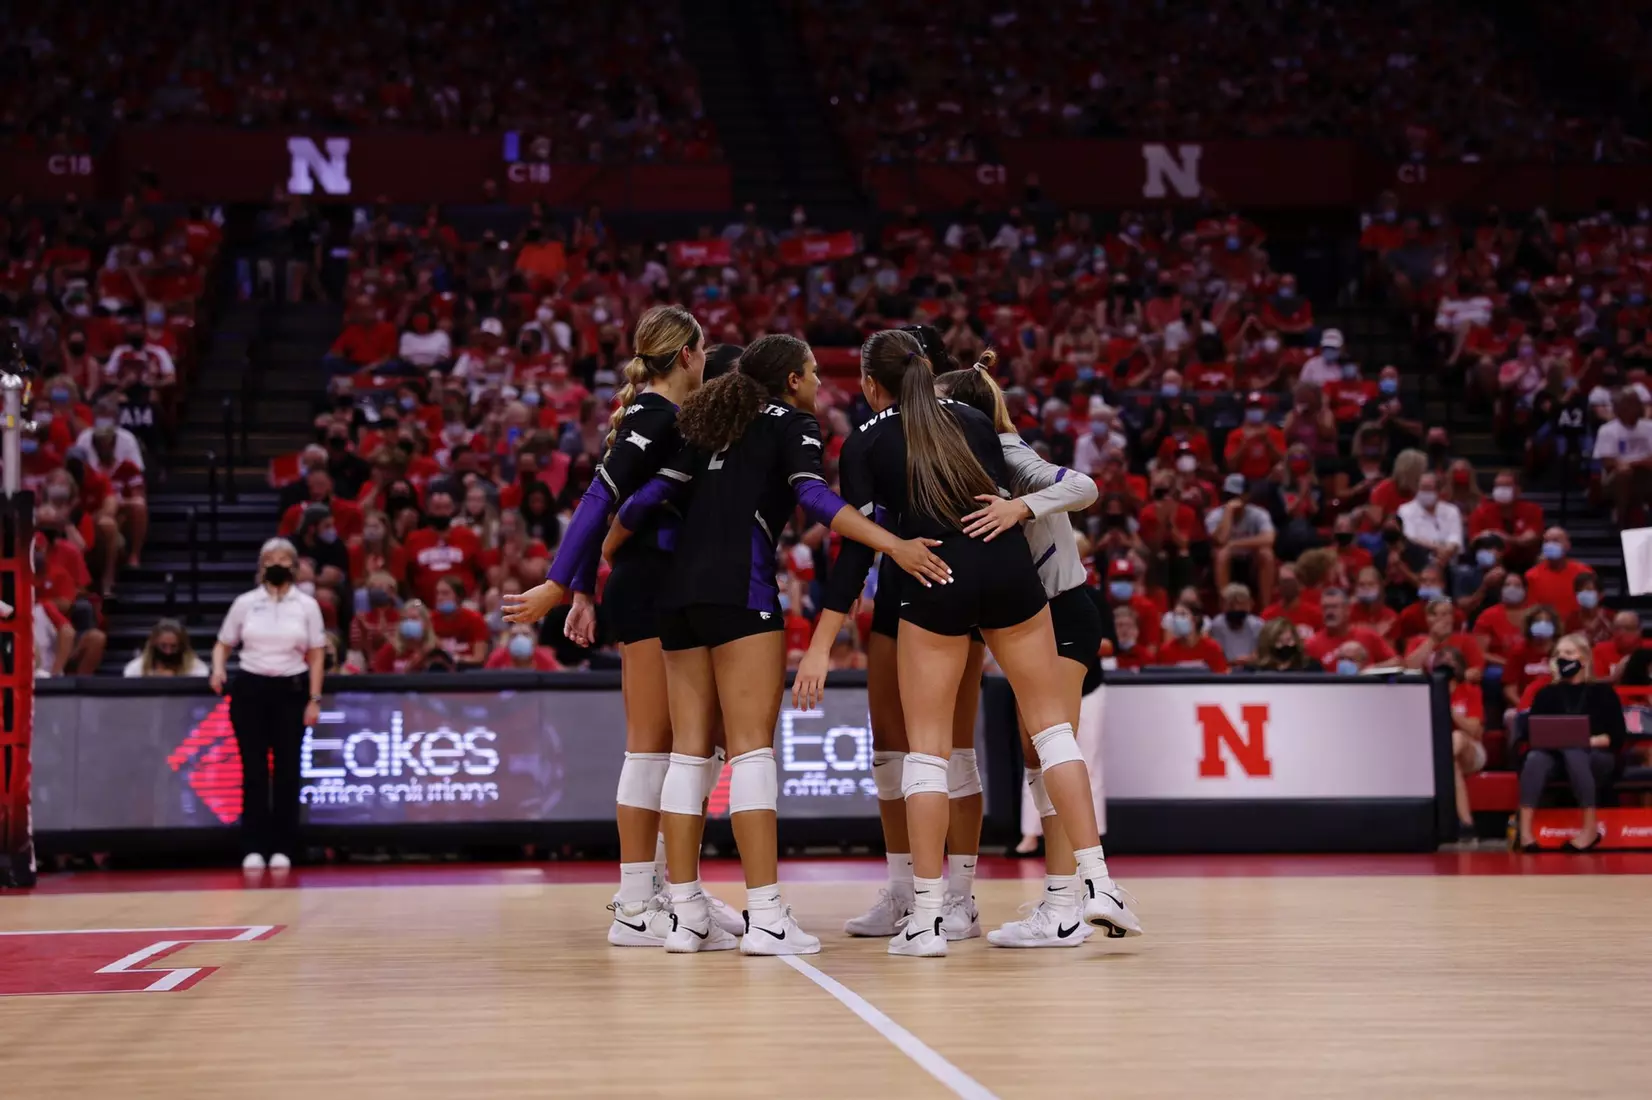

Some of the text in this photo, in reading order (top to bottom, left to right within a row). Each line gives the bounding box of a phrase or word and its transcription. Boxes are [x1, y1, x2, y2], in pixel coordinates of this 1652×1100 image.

[47, 154, 94, 176] C18
[286, 136, 351, 195] N
[976, 162, 1007, 185] C1
[1142, 142, 1203, 198] N
[120, 405, 154, 428] A14
[1557, 407, 1585, 429] A2
[300, 710, 500, 778] Eakes
[782, 708, 874, 771] Ea
[1195, 704, 1272, 777] N
[300, 777, 376, 804] office
